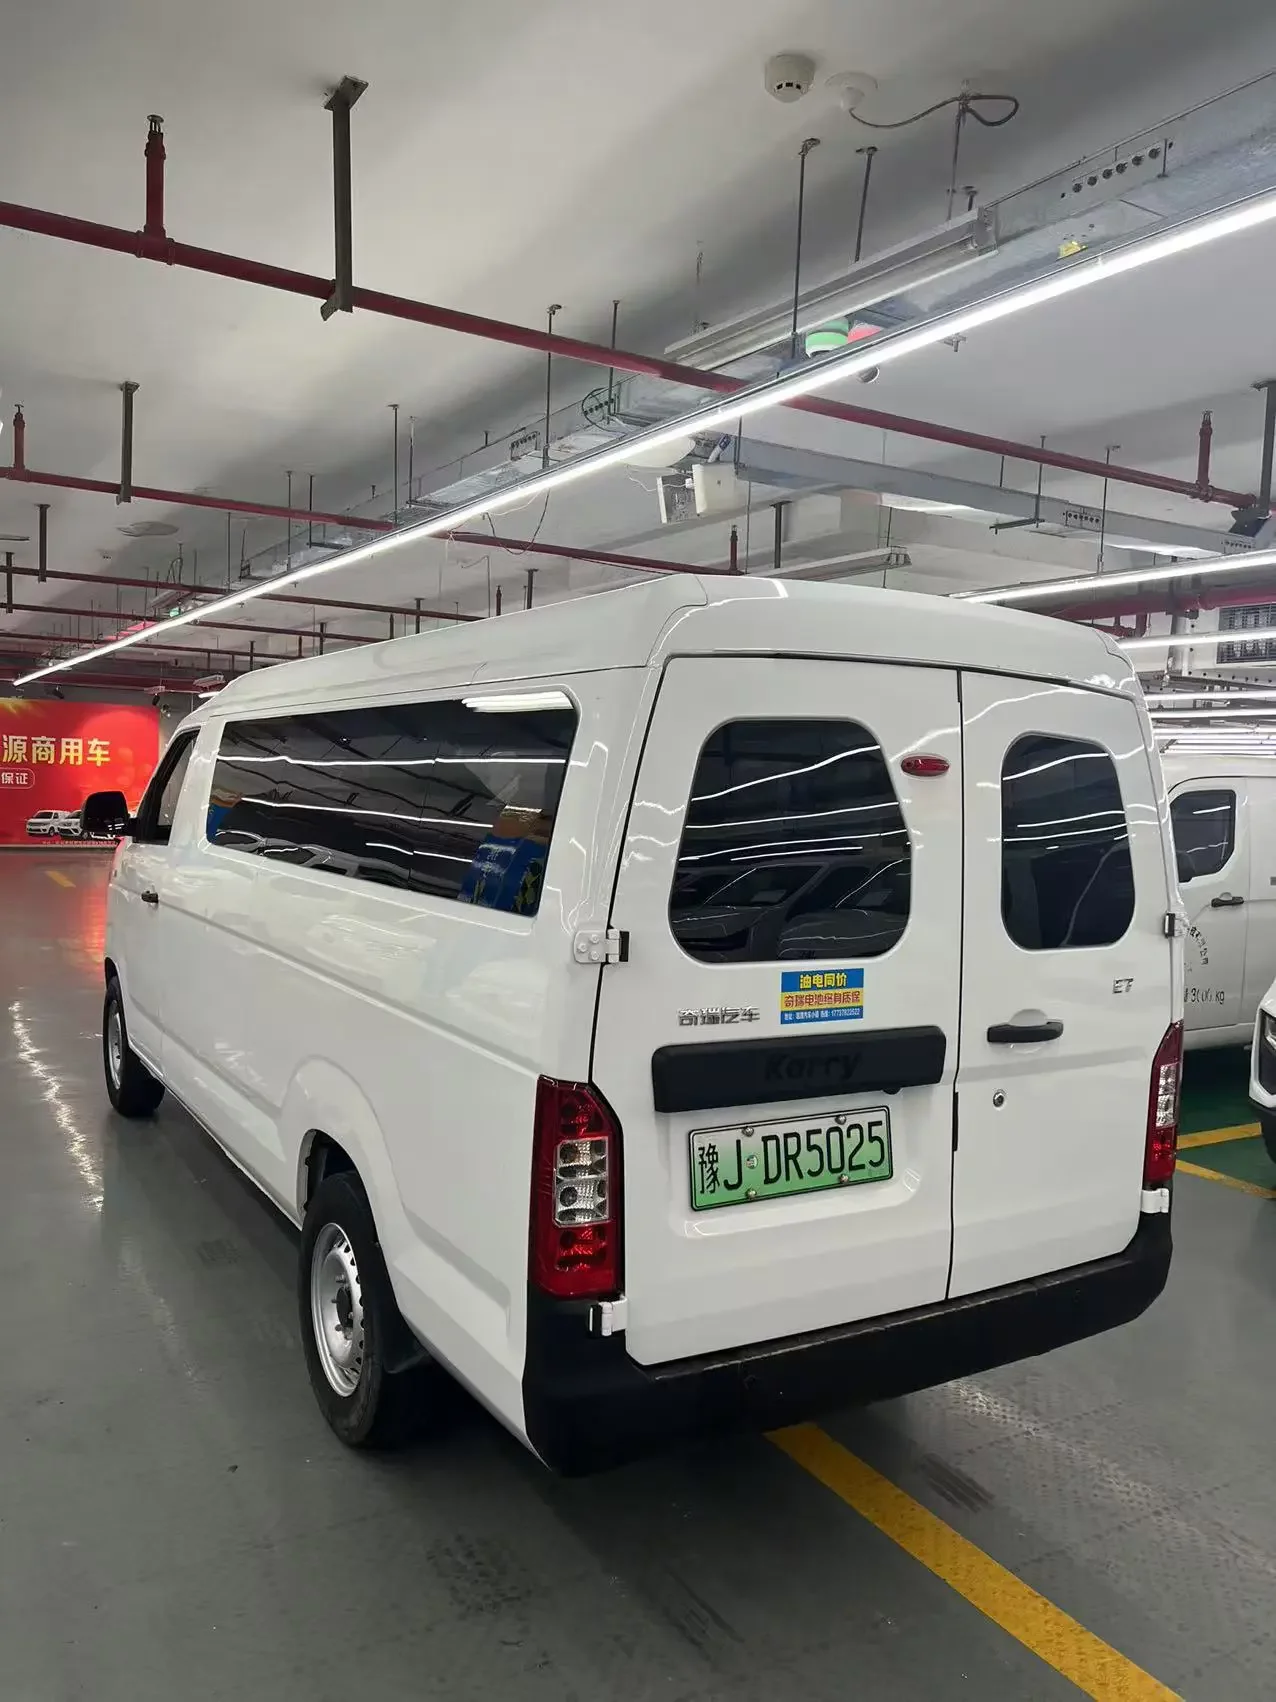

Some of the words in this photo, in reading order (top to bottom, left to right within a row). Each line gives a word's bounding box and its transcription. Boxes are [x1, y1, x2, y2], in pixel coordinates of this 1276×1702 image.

[2, 735, 111, 766] 源商用车
[1, 772, 28, 785] 保证
[800, 972, 847, 989] 油电同价
[678, 1006, 760, 1026] 奇瑞汽车
[764, 1051, 863, 1082] Karry
